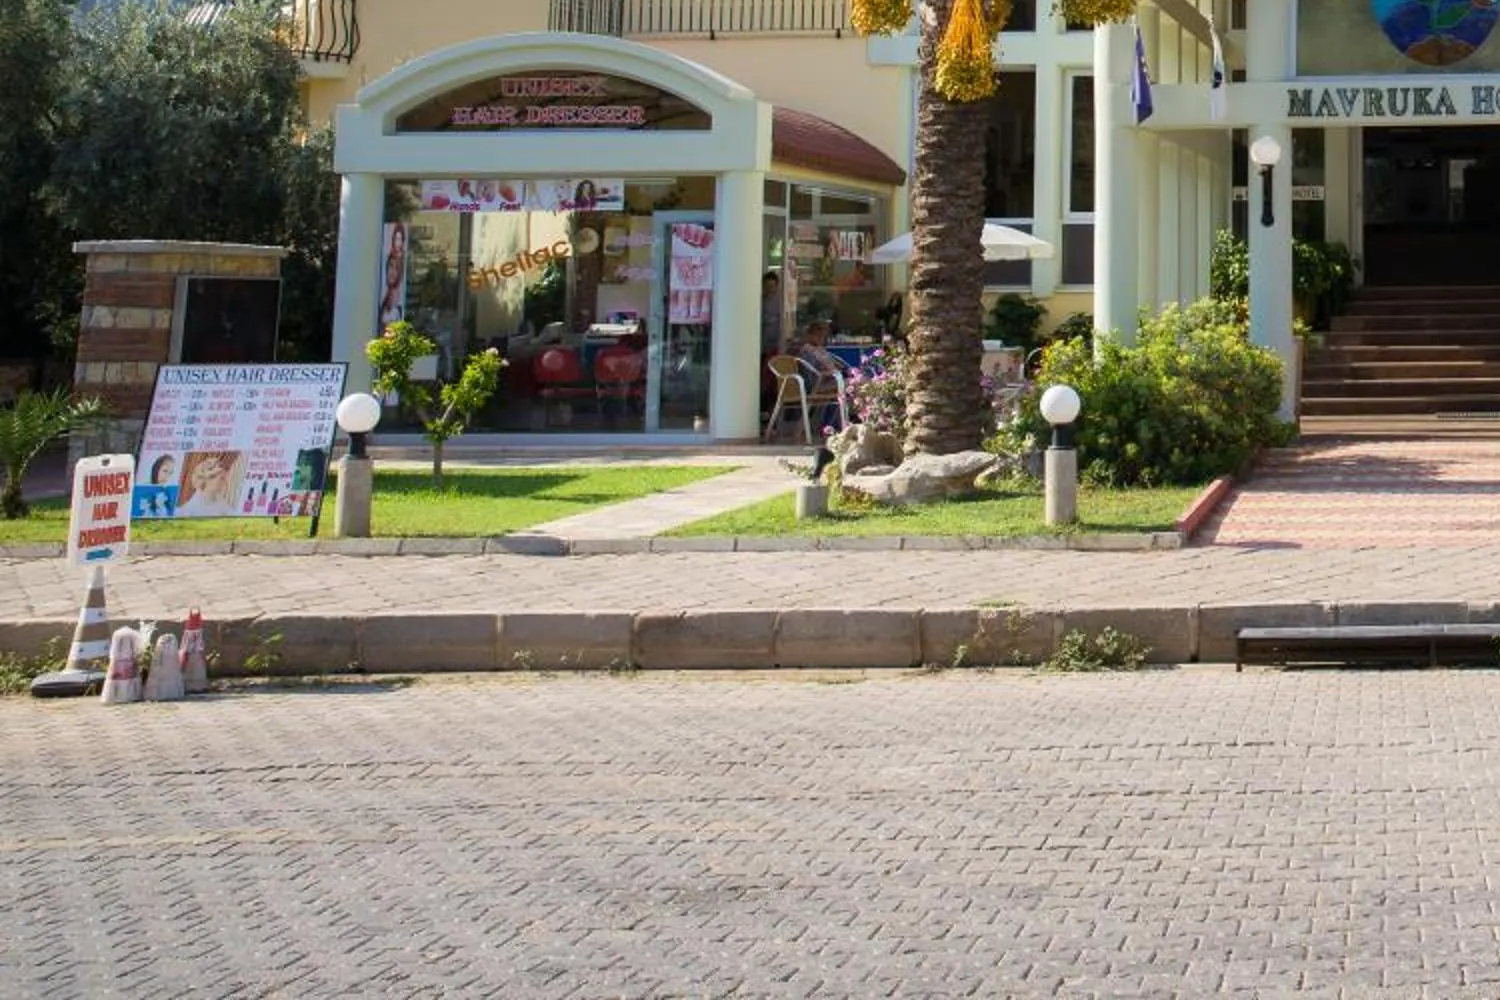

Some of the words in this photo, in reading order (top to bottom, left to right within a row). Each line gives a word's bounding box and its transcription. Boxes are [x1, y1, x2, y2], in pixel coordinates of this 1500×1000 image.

[501, 77, 607, 97] UNISEX
[1287, 87, 1456, 117] MAVRUKA
[451, 106, 517, 125] HAIR
[525, 105, 646, 125] DRESSER
[163, 367, 220, 384] UNISEX
[225, 367, 265, 383] HAIR
[269, 366, 342, 383] DRESSER
